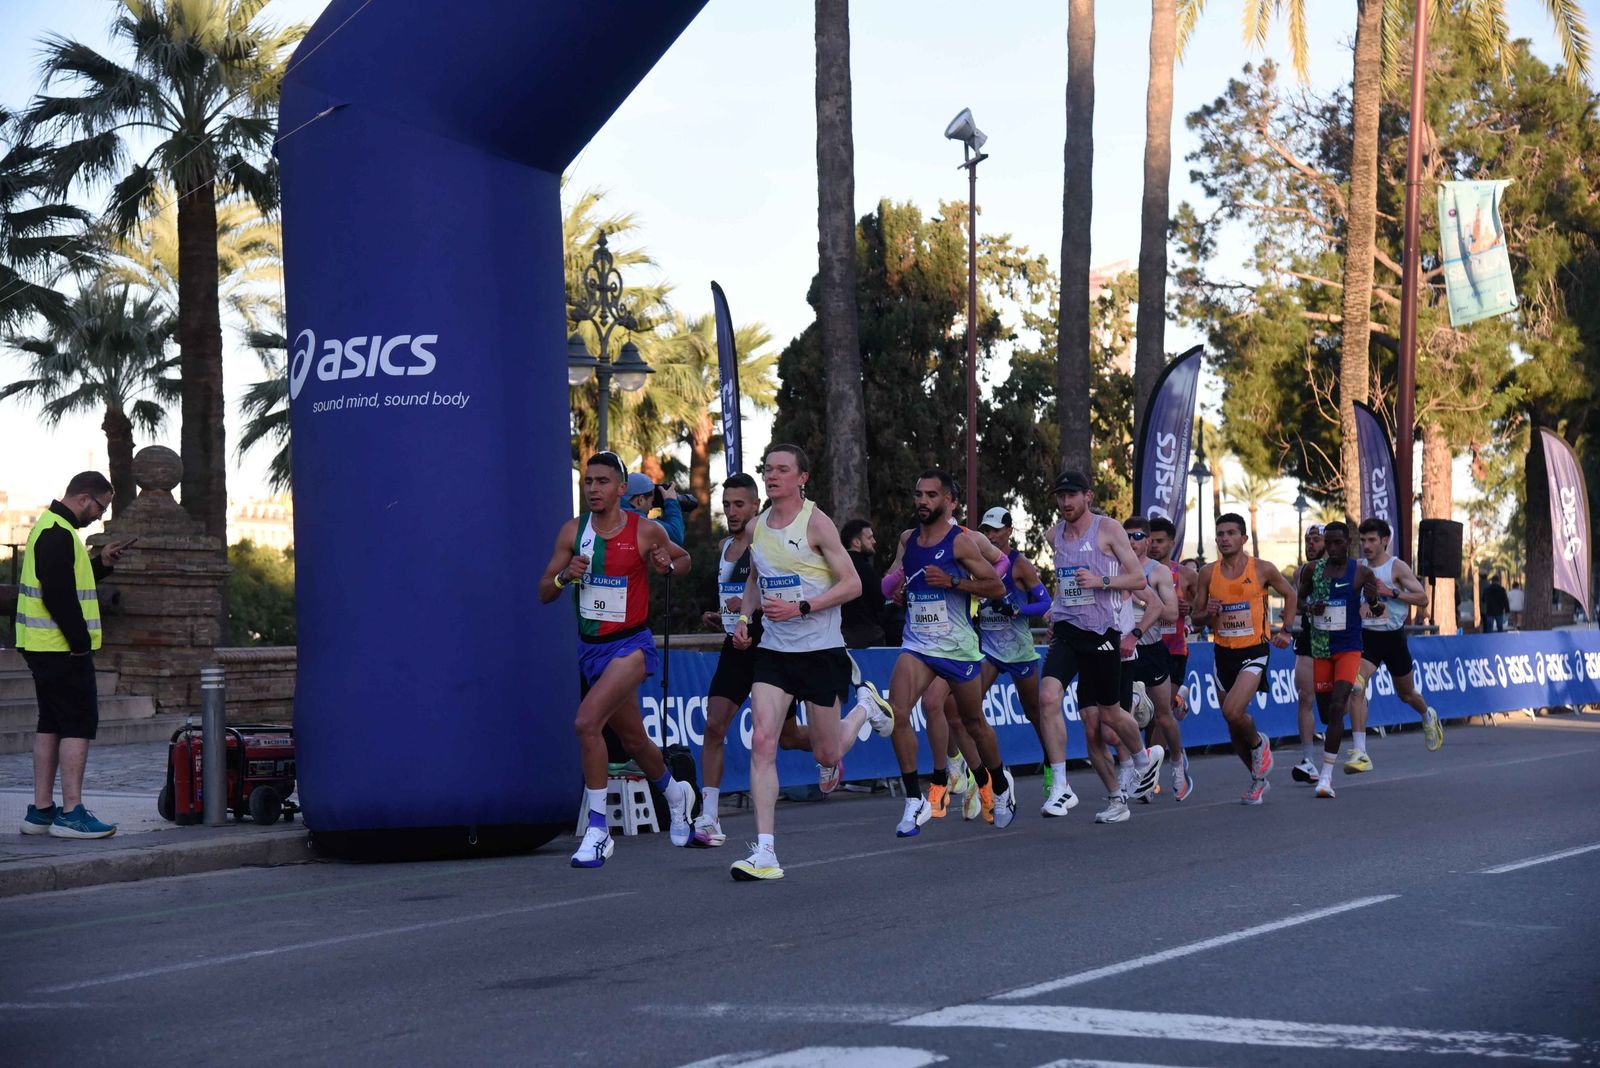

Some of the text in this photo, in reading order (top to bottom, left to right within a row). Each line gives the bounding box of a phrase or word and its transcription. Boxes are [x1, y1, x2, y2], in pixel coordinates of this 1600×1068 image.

[317, 335, 438, 381] asics
[313, 391, 470, 413] sound mind, sound body
[1155, 432, 1176, 503] asics
[593, 577, 621, 586] ZURICH
[1064, 588, 1082, 597] REED
[593, 600, 606, 609] 50
[1225, 602, 1246, 610] ZURICH
[915, 613, 939, 622] OUHDA
[1223, 620, 1246, 629] YONAH
[1423, 661, 1454, 692] asics
[1465, 658, 1496, 688] asics
[1505, 655, 1534, 684] asics
[1545, 653, 1573, 681] asics
